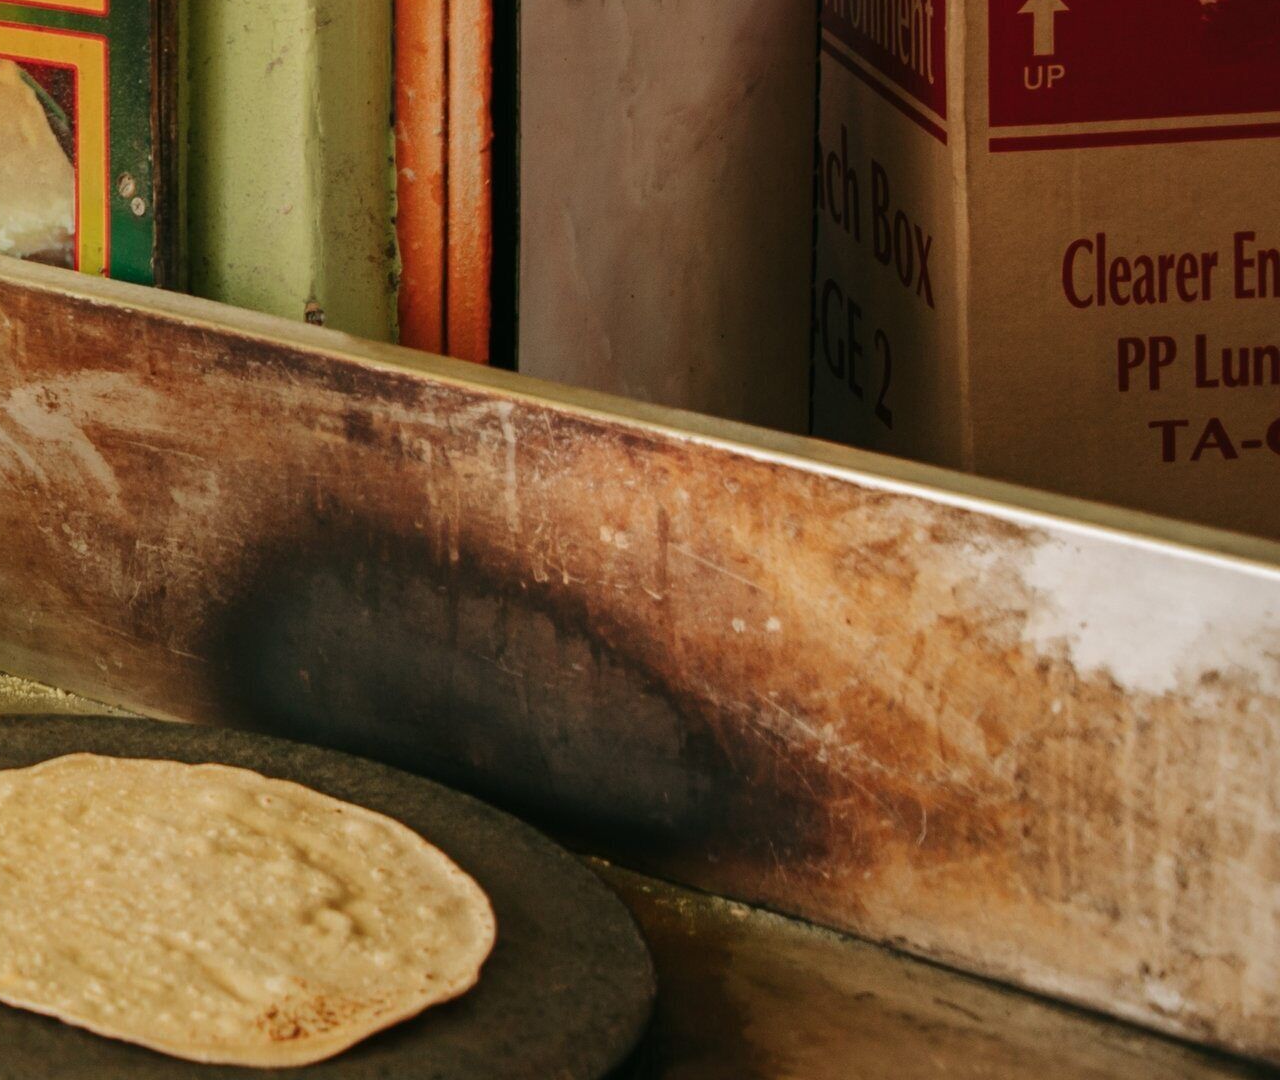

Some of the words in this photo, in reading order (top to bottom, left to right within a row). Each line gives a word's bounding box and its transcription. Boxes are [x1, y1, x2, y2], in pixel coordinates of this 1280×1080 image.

[1024, 65, 1066, 90] UP
[871, 158, 935, 309] Box
[1062, 232, 1218, 309] Clearer
[1233, 231, 1280, 299] En
[874, 328, 893, 431] 2
[1118, 336, 1178, 392] PP
[1195, 334, 1280, 389] Lun
